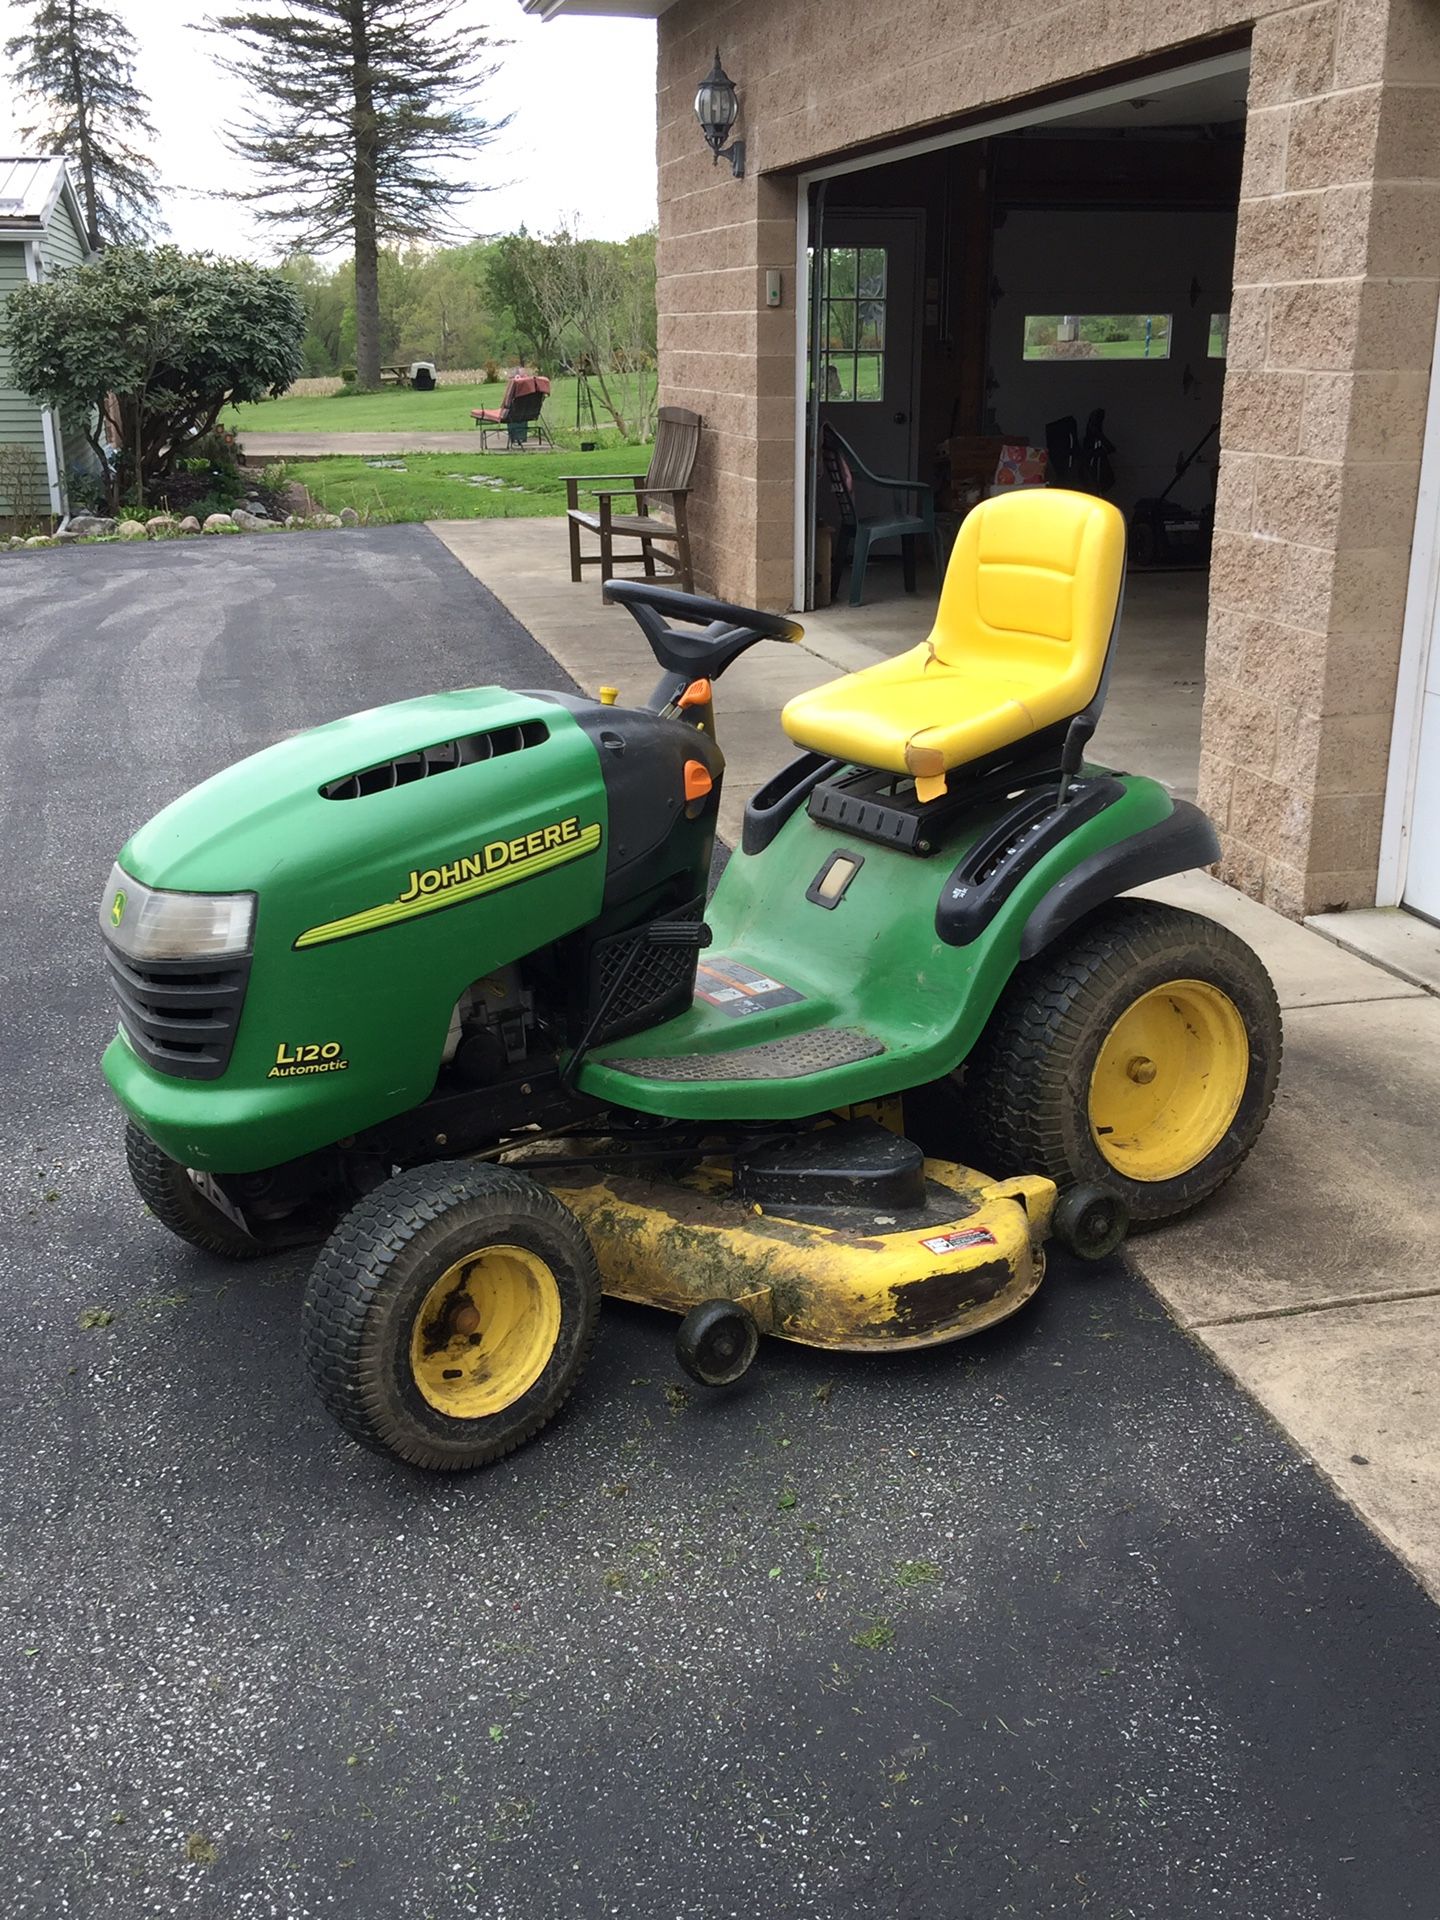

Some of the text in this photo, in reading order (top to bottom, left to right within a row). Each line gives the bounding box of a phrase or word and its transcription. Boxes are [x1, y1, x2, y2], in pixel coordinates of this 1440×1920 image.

[400, 817, 579, 901] JOHN DEERE
[276, 1042, 340, 1064] L120
[268, 1060, 348, 1077] Automatic
